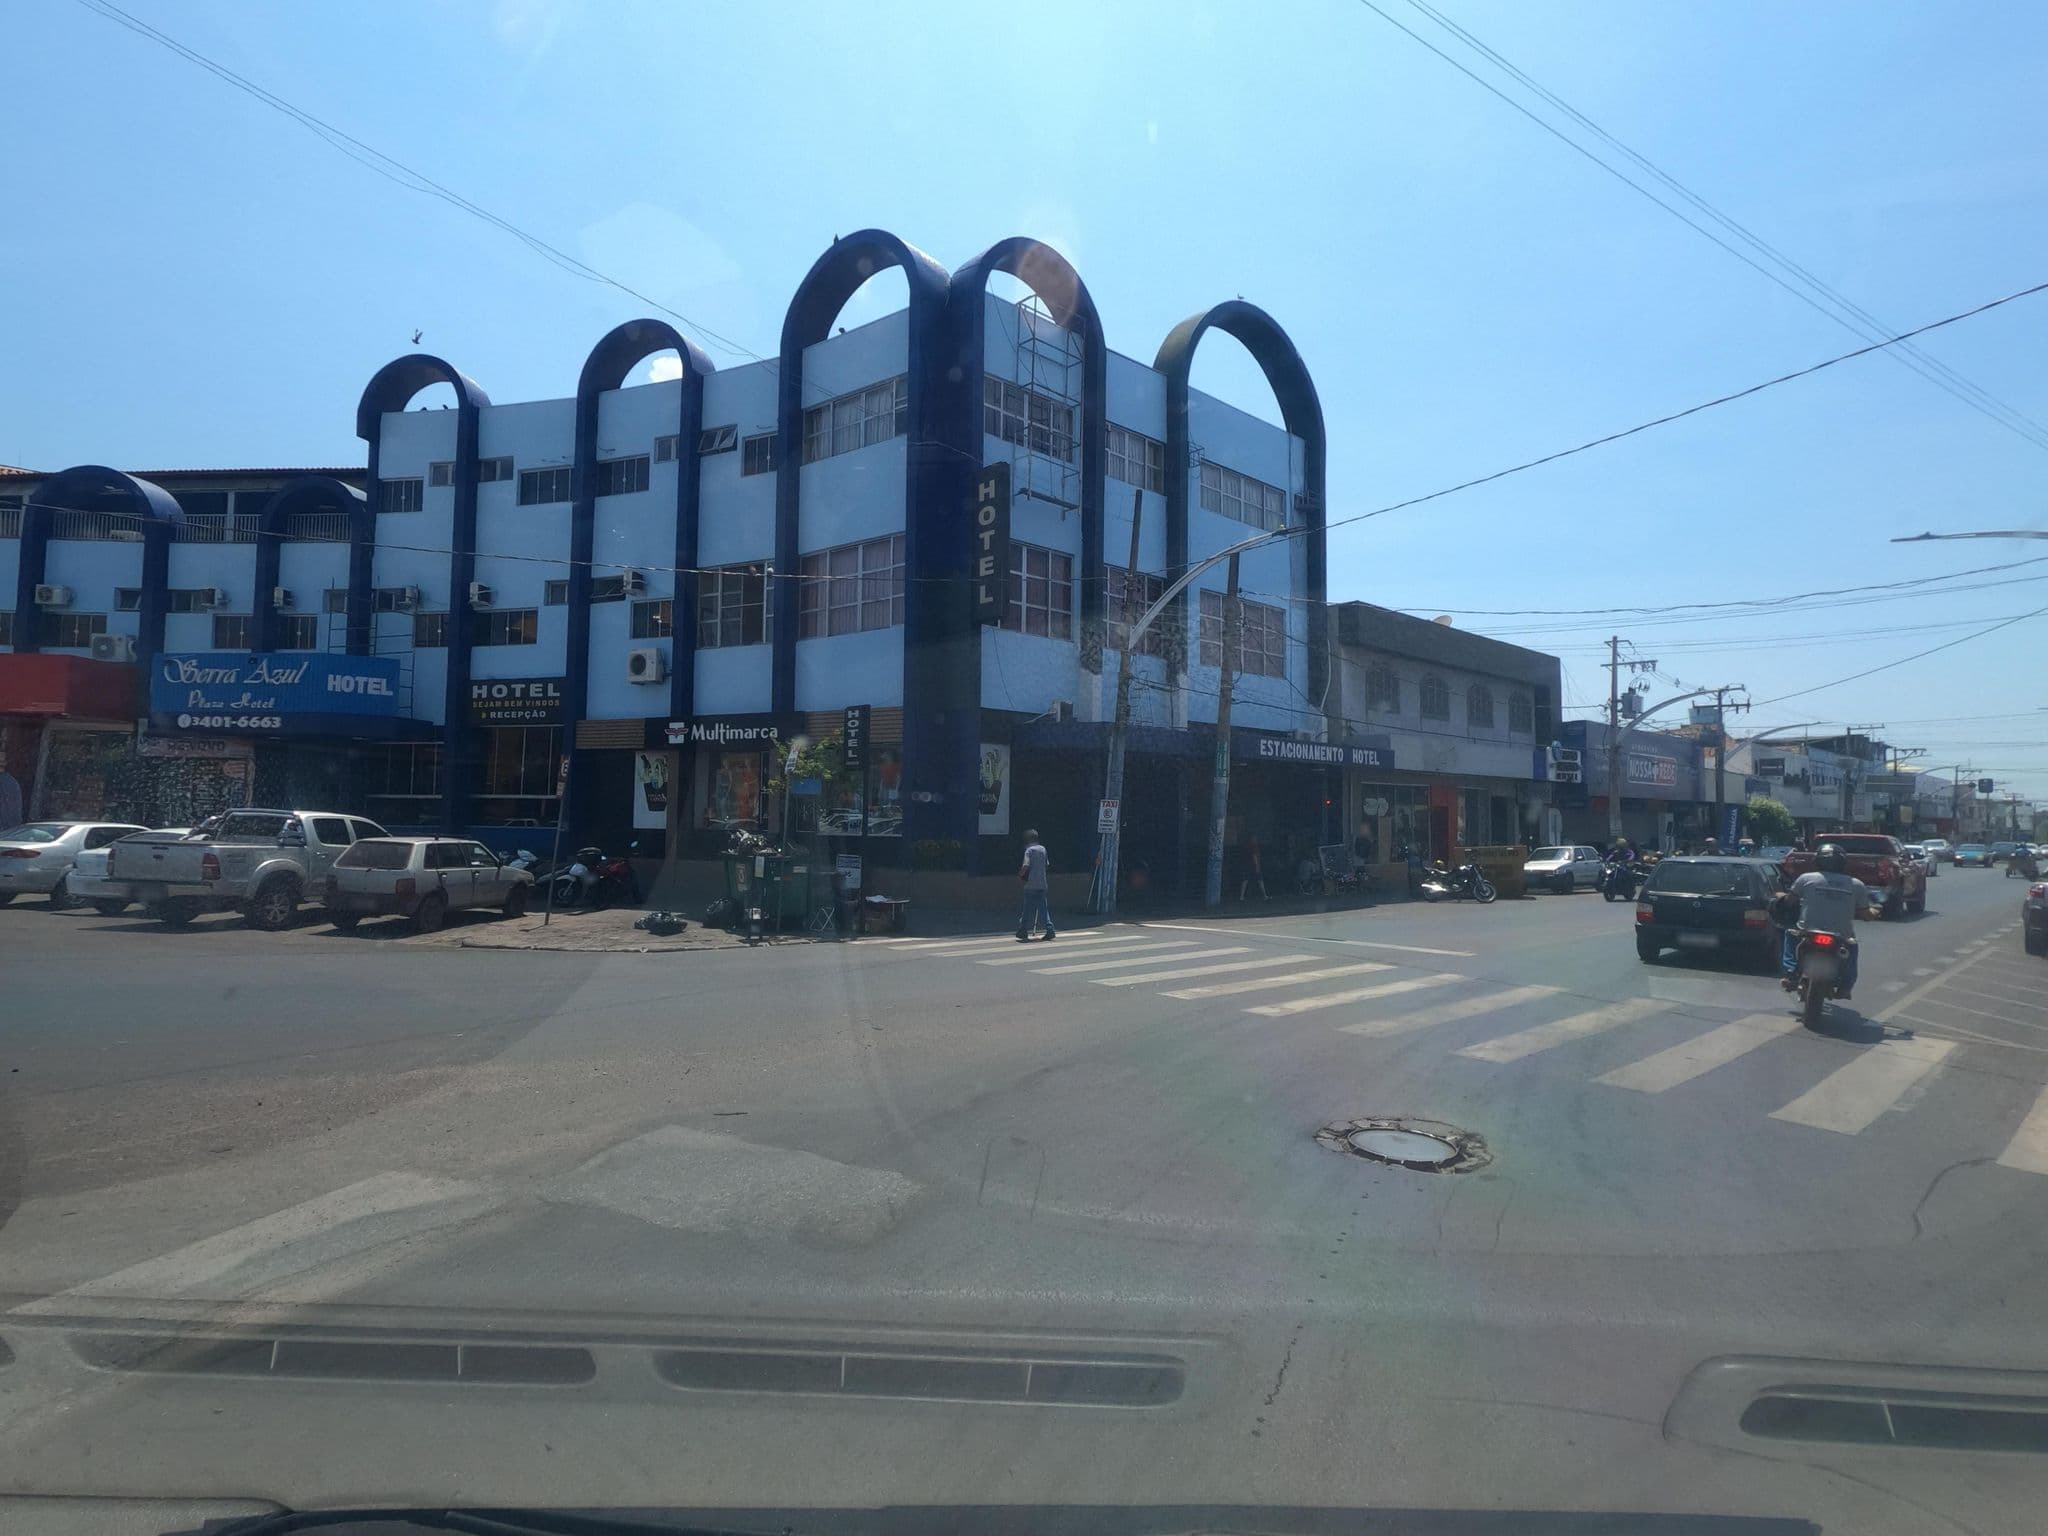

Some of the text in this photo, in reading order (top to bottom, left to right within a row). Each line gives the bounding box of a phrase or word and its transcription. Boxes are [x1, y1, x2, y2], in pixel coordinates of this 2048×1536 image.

[978, 479, 995, 604] HOTEL
[164, 657, 309, 685] Serra Azul
[327, 674, 393, 696] HOTEL
[472, 683, 560, 699] HOTEL
[231, 692, 274, 709] Hotel
[473, 699, 560, 708] SEJAM BEM VINDOS
[192, 716, 281, 729] 3401-6663
[490, 709, 546, 720] RECEPÇÃO
[691, 722, 778, 744] Multimarca
[848, 710, 859, 758] HOTEL
[1260, 739, 1380, 766] ESTACIONAMENTO HOTEL
[1630, 760, 1653, 779] NOSSA
[1101, 800, 1119, 808] TAXI
